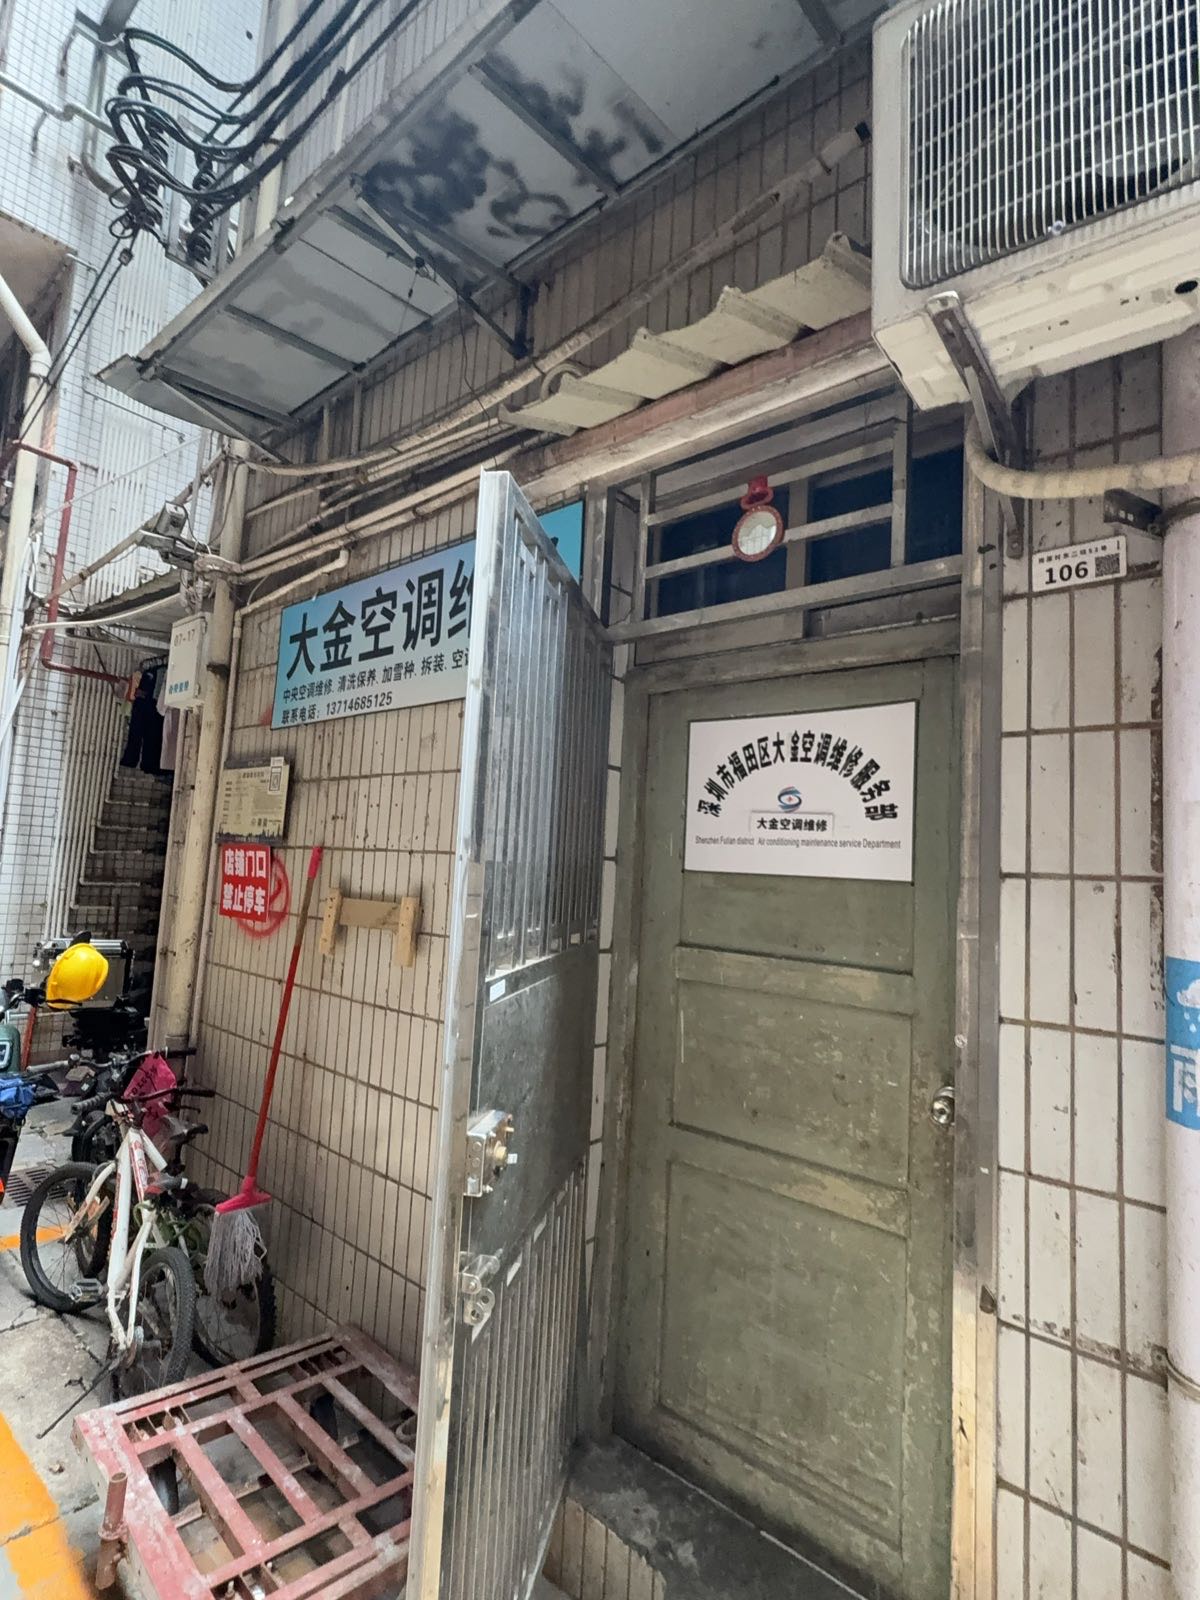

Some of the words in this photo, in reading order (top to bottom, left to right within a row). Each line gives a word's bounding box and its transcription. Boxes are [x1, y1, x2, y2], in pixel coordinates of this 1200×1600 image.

[1045, 561, 1089, 585] 106
[756, 817, 828, 833] 大金空调维修
[765, 837, 800, 848] conditioning
[801, 838, 838, 848] maintenance
[838, 839, 862, 849] service
[862, 839, 901, 850] Department
[224, 848, 267, 879] 店铺门口
[222, 882, 266, 915] 禁止停车
